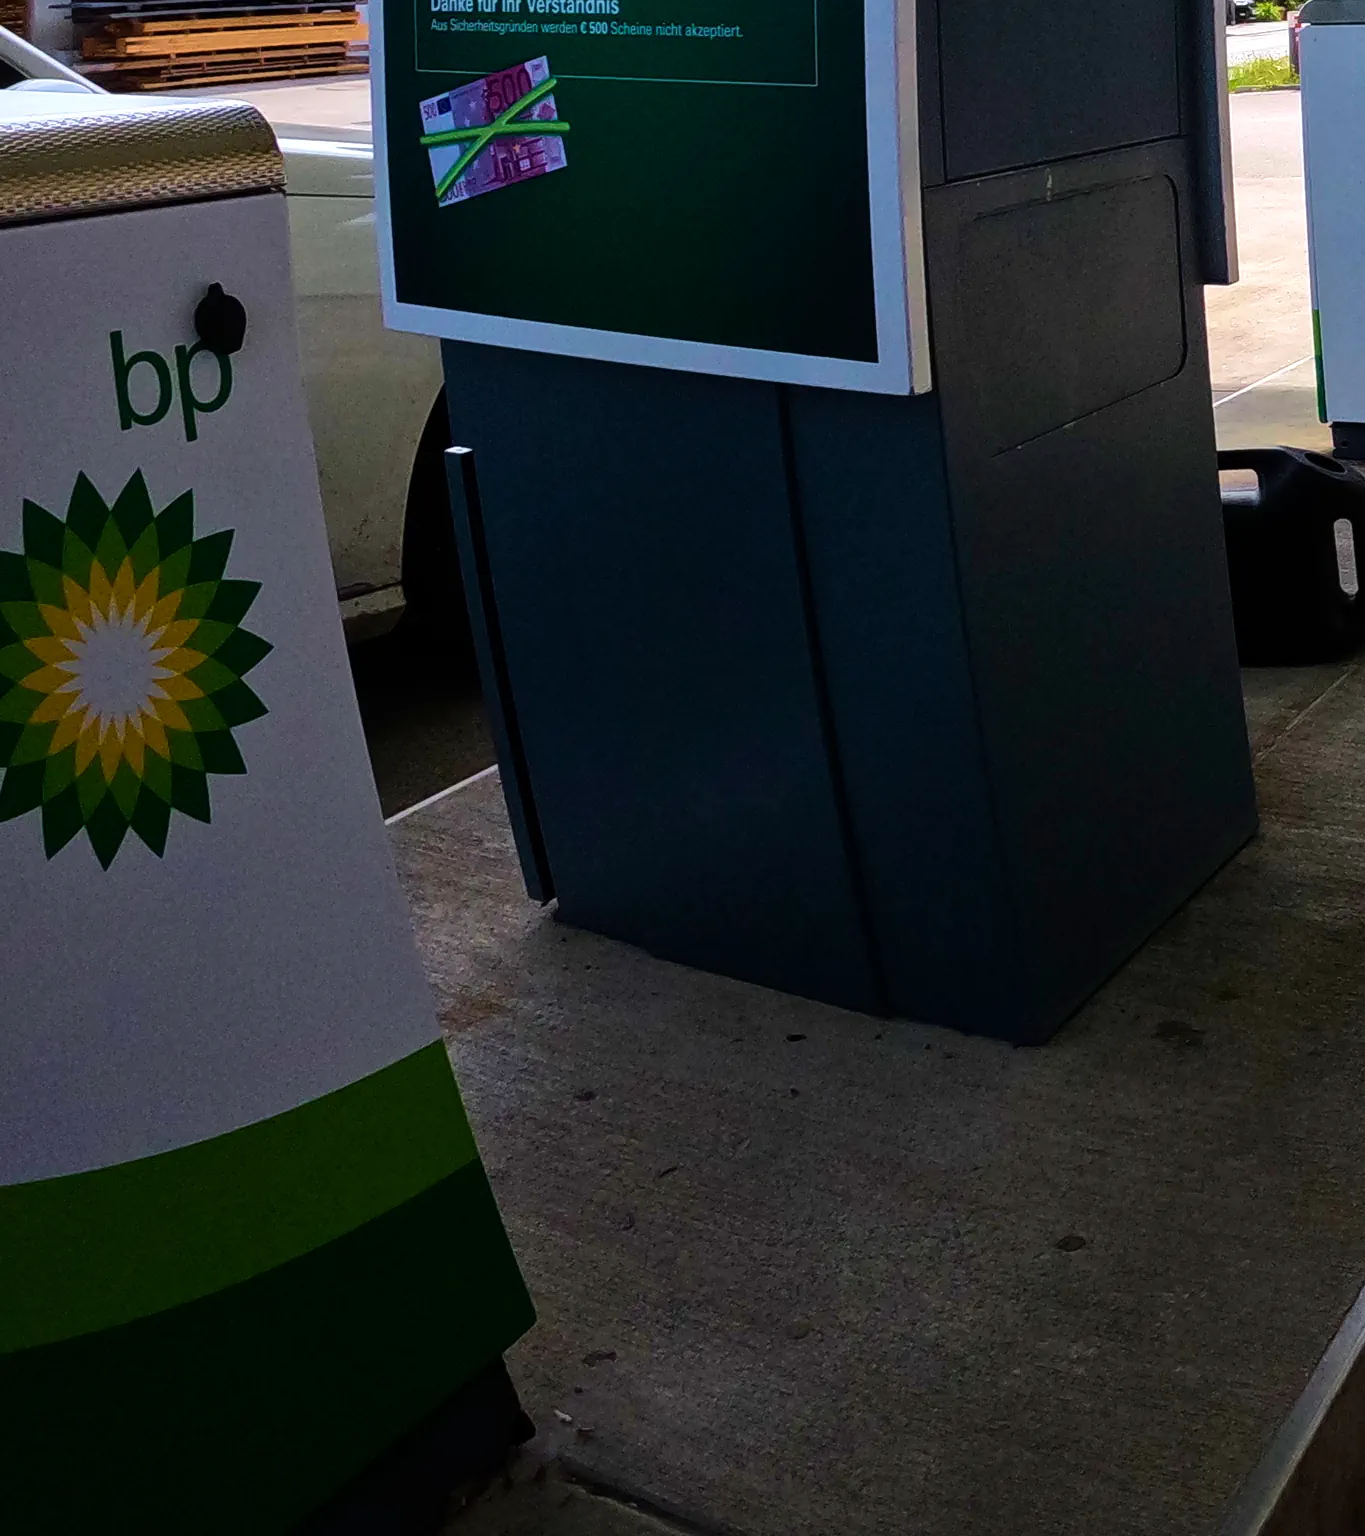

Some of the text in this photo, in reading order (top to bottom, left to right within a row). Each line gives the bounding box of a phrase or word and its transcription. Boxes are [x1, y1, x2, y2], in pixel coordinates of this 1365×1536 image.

[430, 18, 744, 40] Aus Sicherheitsgründen werden € 500 Scheine nicht akzeptiert.
[109, 330, 233, 443] bp
